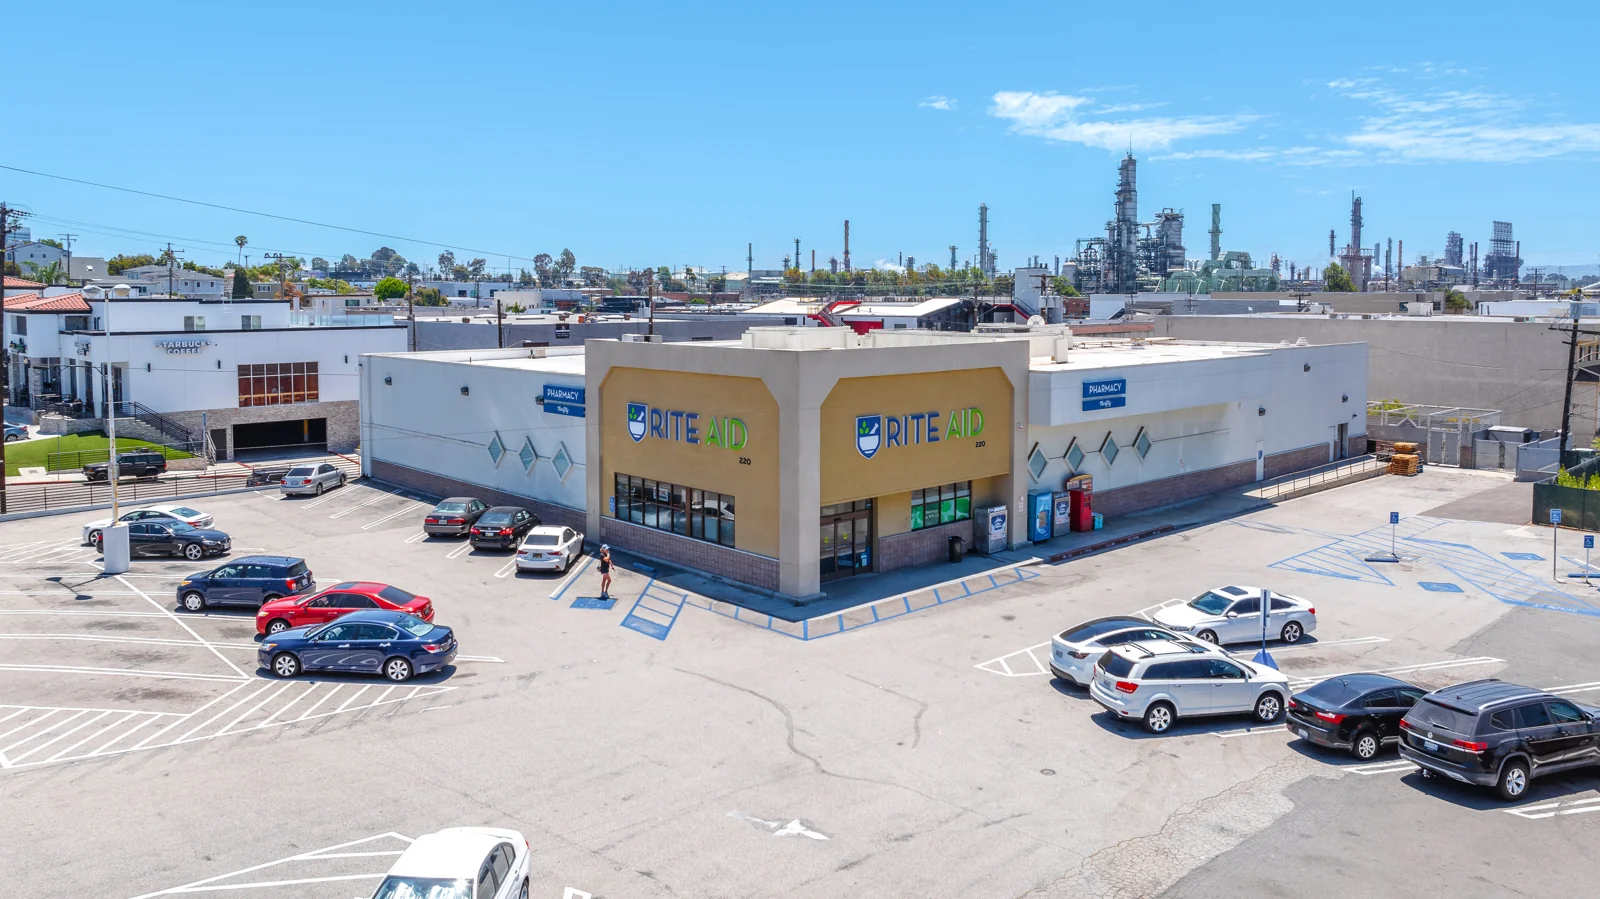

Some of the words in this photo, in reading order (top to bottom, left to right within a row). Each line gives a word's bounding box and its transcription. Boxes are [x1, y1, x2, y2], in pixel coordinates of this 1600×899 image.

[156, 340, 212, 348] STARBUCKS
[547, 388, 579, 400] PHARMACY
[1089, 383, 1122, 394] PHARMACY
[650, 407, 701, 445] RITE
[705, 415, 748, 451] AID
[885, 411, 940, 448] RITE
[944, 407, 985, 441] AID
[975, 440, 986, 448] 220
[738, 456, 751, 466] 220
